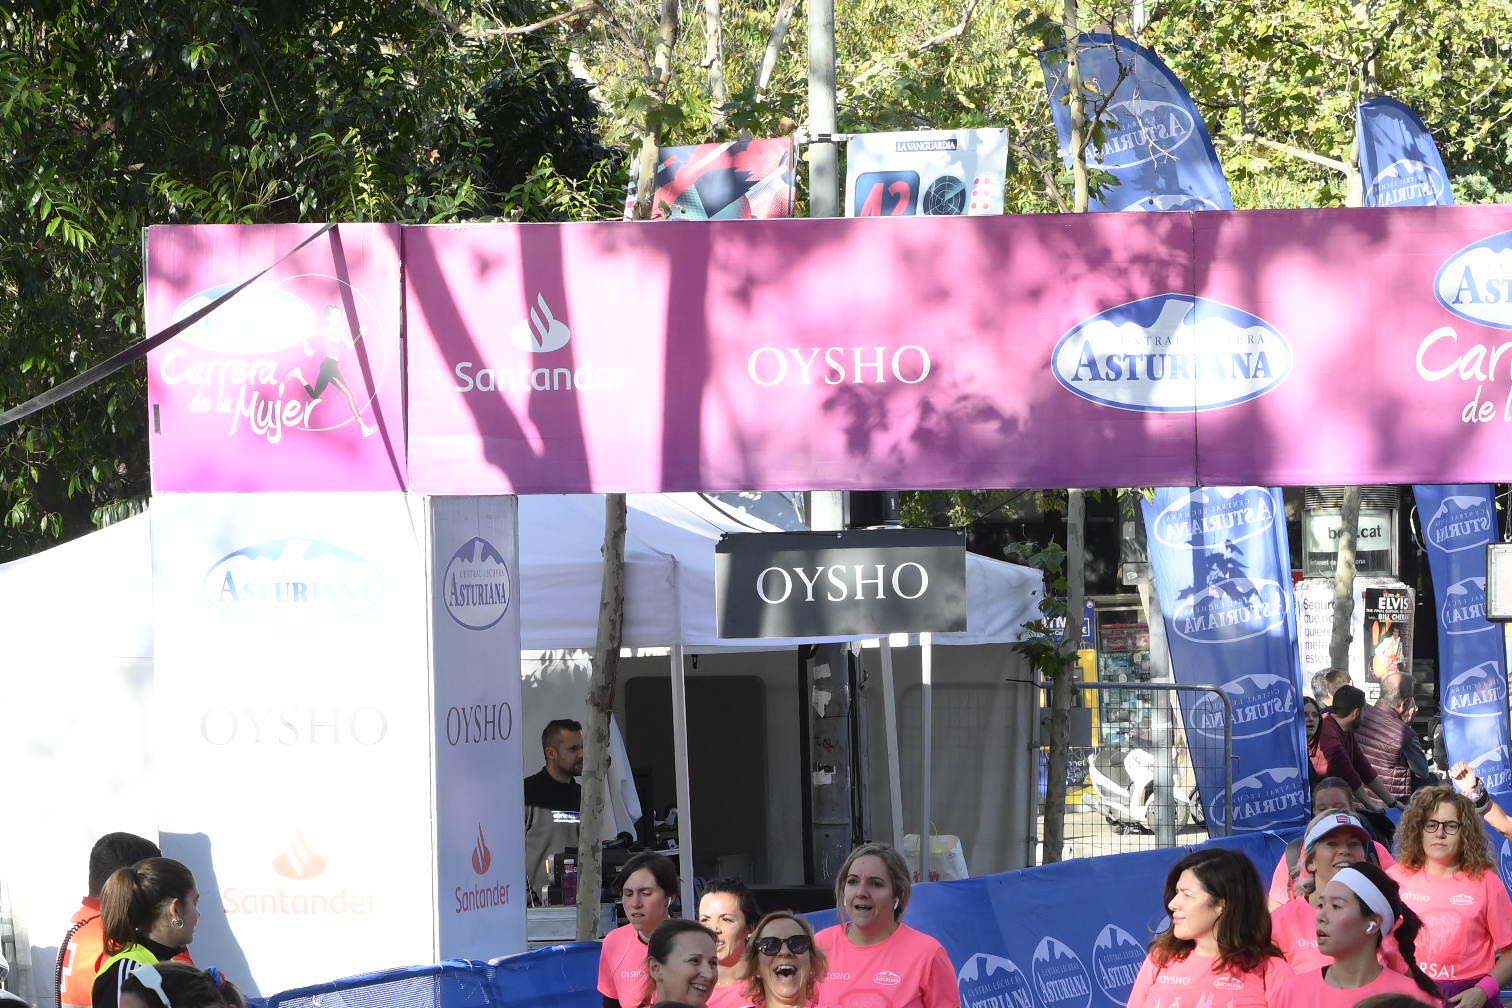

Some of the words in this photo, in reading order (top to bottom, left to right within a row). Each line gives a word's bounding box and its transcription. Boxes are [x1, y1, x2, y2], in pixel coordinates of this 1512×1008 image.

[747, 343, 932, 387] OYSHO
[1070, 338, 1275, 384] ASTURIANA
[228, 383, 323, 445] Mujer
[1460, 383, 1496, 424] de
[449, 572, 507, 607] ASTURIANA
[756, 561, 930, 605] OYSHO
[1378, 597, 1409, 610] ELVIS
[446, 701, 513, 745] OYSHO
[455, 881, 511, 914] Santander
[1037, 971, 1089, 1004] ASTURIANA
[1419, 961, 1457, 978] RSAL
